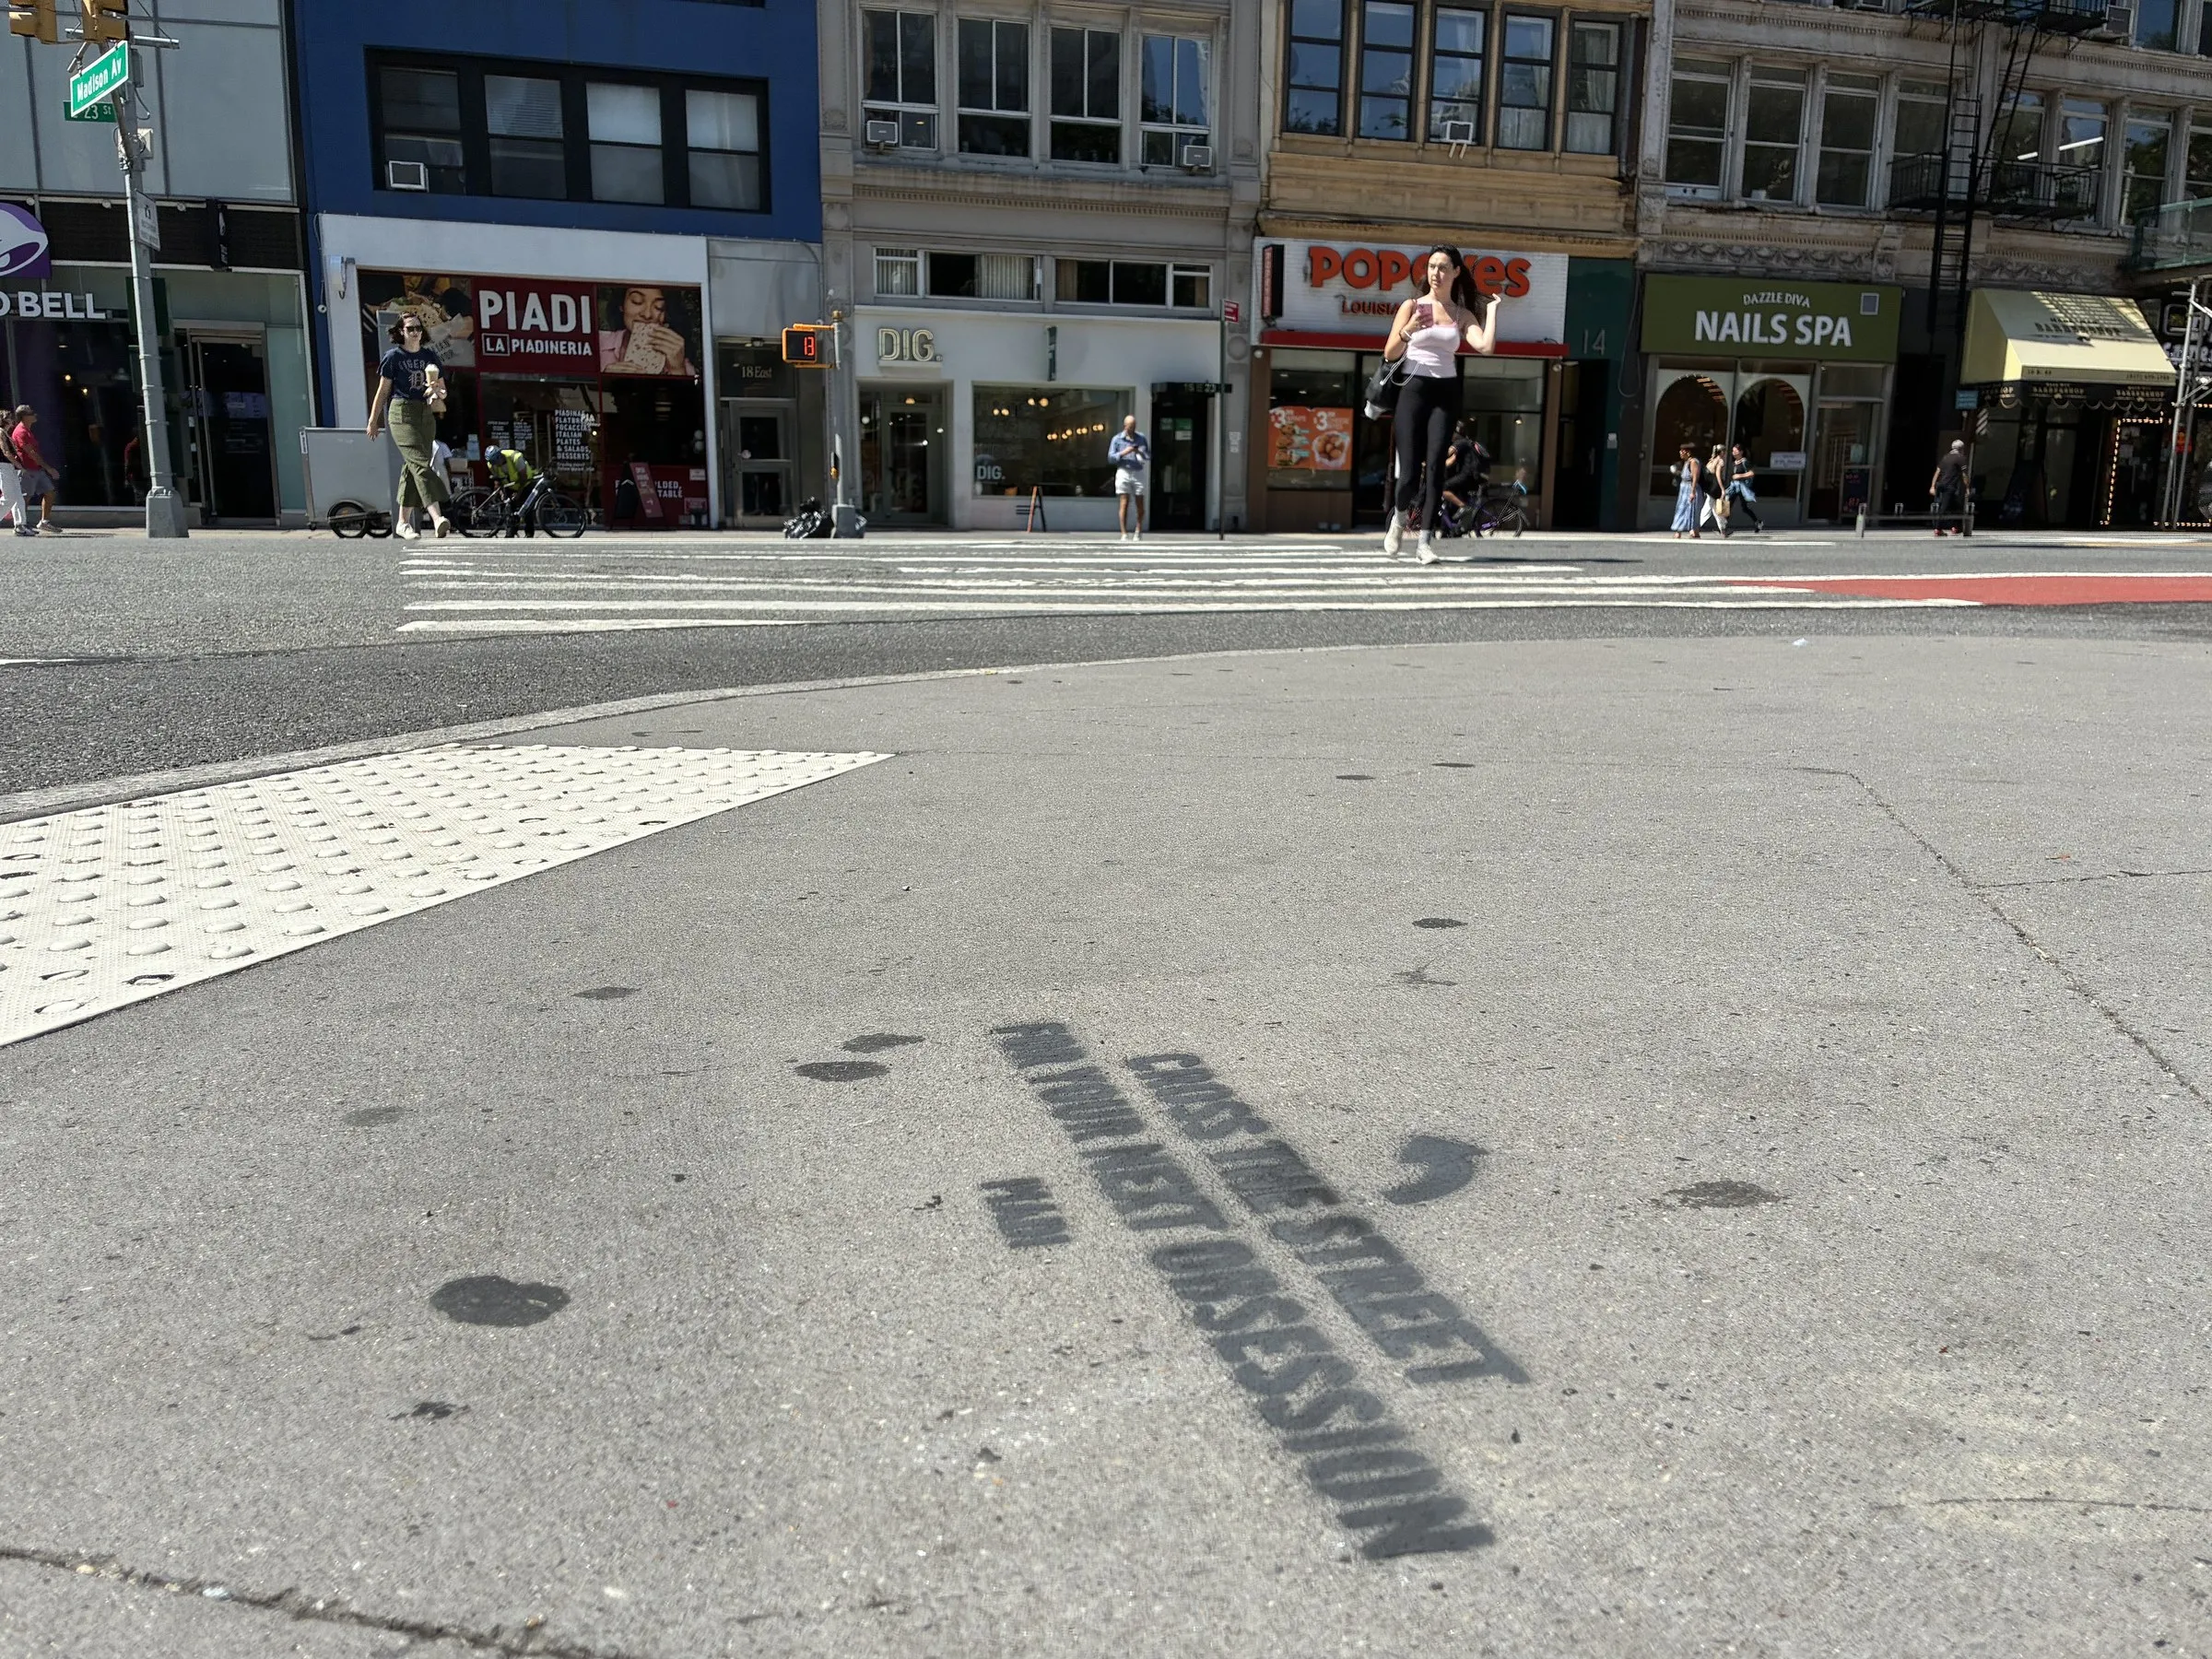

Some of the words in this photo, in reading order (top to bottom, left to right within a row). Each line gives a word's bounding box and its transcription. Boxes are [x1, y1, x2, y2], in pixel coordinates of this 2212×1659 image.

[76, 68, 109, 102] Madison
[112, 57, 123, 79] Av
[84, 104, 99, 120] 23
[102, 105, 112, 115] St
[18, 290, 107, 320] BELL
[478, 289, 592, 335] PIADI
[1743, 291, 1783, 306] DAZZLE
[1784, 292, 1811, 309] DIVA
[485, 336, 506, 352] LA
[511, 338, 593, 357] PIADINERIA
[804, 335, 816, 357] 13
[1583, 328, 1606, 356] 14
[1694, 310, 1788, 345] NAILS
[1794, 314, 1853, 347] SPA
[398, 358, 431, 371] TIGER
[1028, 1066, 1146, 1143] YOUR
[1125, 1053, 1271, 1141] CROSS
[1079, 1143, 1230, 1231] NEXT
[1206, 1138, 1347, 1215] THE
[1266, 1211, 1531, 1384] STREET
[1148, 1239, 1495, 1559] OBSESSION
